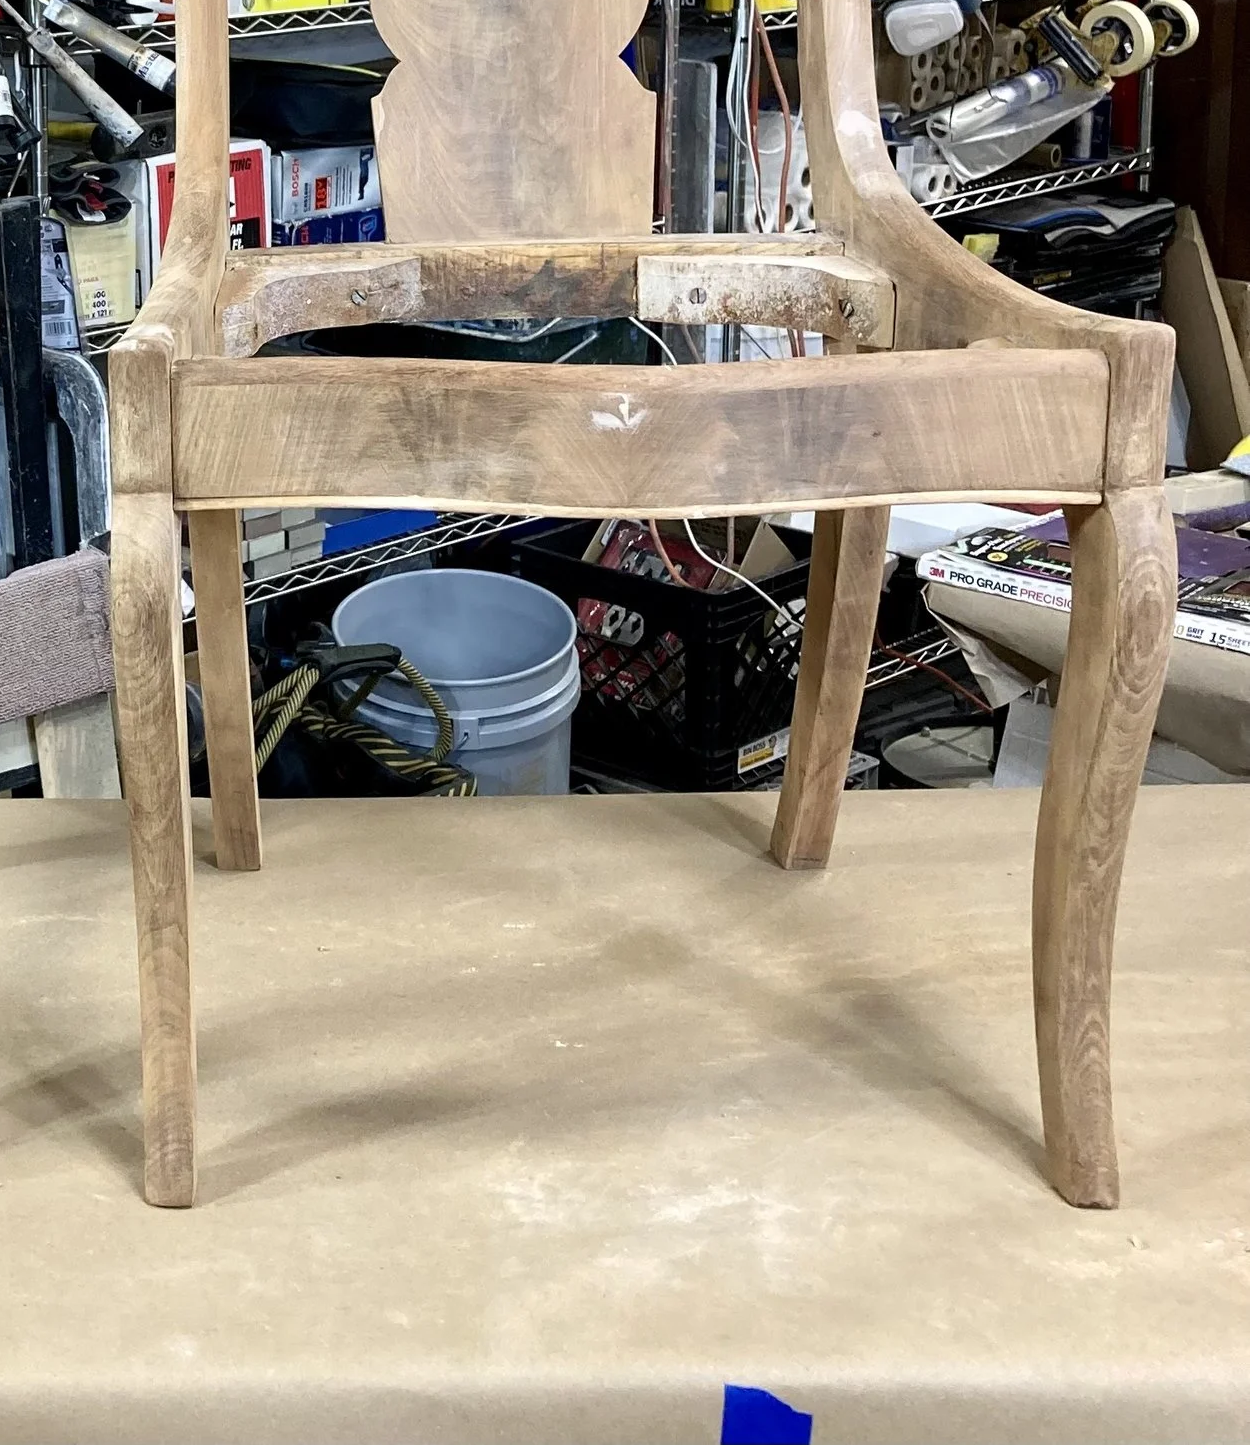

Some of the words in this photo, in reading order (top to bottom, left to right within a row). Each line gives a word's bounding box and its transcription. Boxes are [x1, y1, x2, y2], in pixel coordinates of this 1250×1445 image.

[291, 157, 302, 198] BOSCH
[929, 566, 946, 579] 3M
[949, 570, 975, 586] PRO
[976, 577, 1019, 597] GRADE
[1208, 632, 1228, 646] 15
